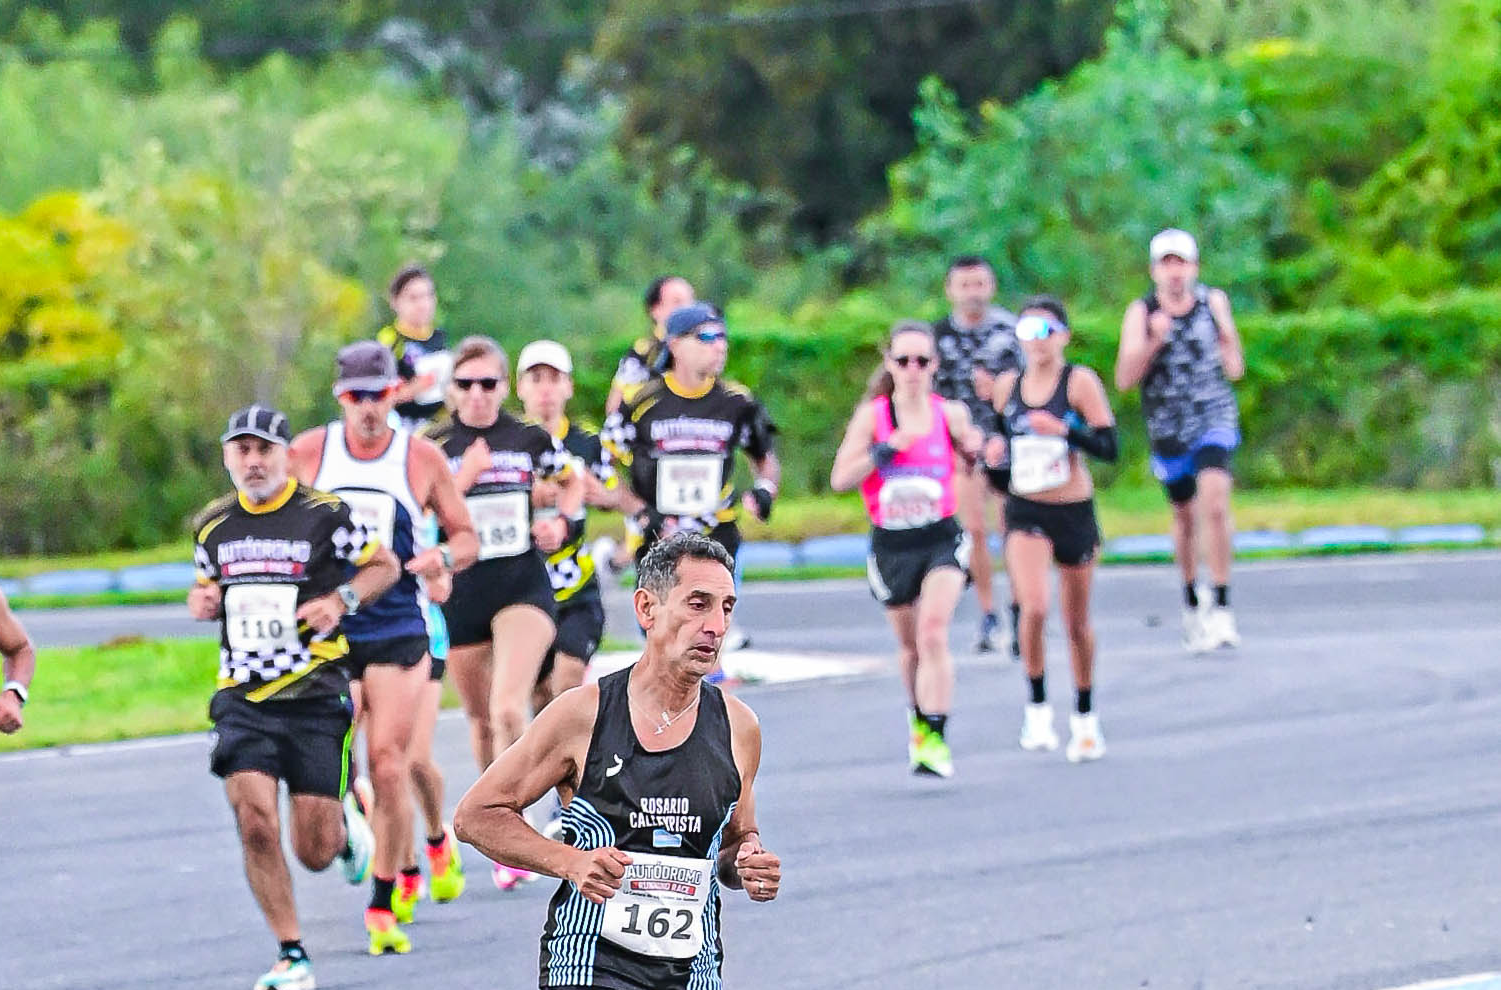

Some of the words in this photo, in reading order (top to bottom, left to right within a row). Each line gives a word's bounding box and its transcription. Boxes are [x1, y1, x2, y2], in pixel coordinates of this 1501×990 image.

[241, 619, 283, 639] 110
[640, 797, 690, 814] ROSARIO
[626, 861, 703, 885] AUTÓDROMO
[621, 903, 694, 940] 162
